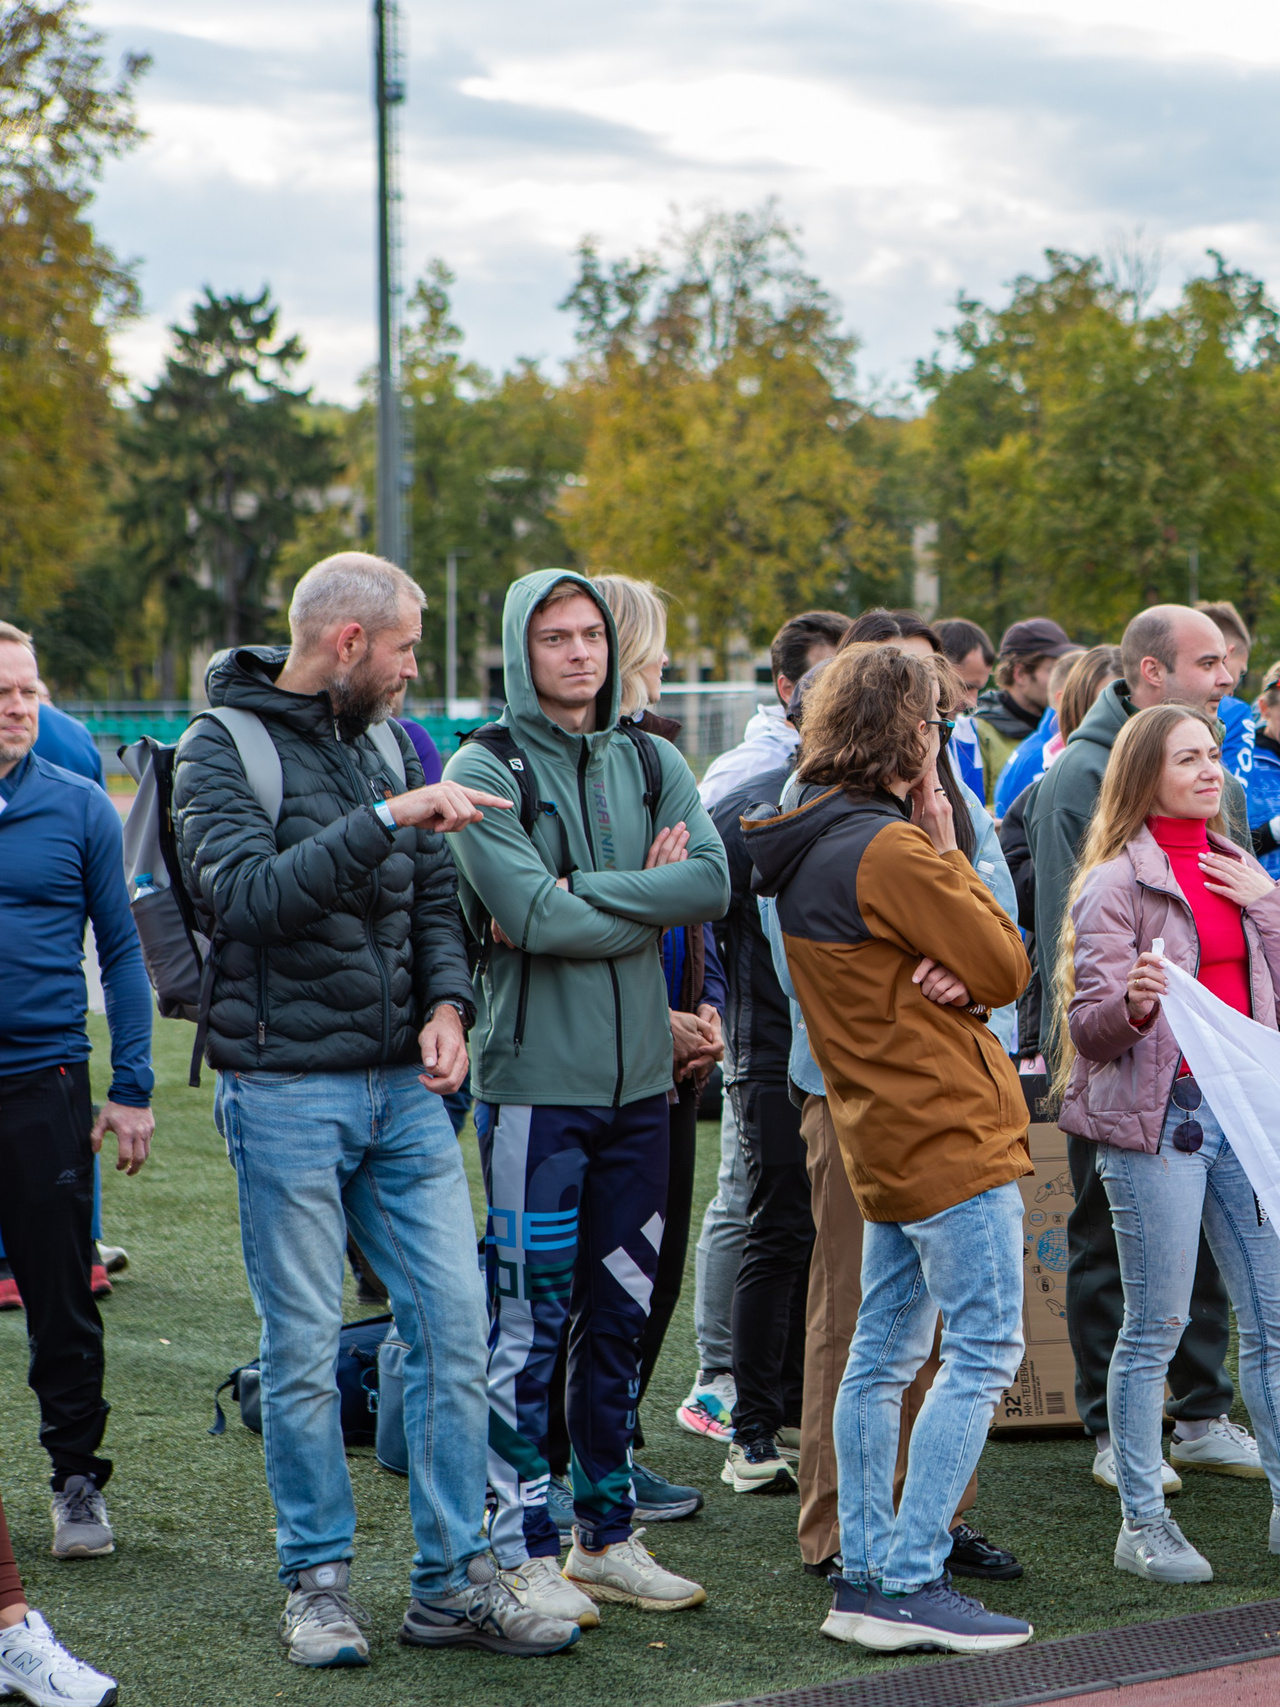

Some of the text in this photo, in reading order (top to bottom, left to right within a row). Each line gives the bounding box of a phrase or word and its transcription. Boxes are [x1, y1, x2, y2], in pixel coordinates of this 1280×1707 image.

[593, 780, 617, 870] TRAININ
[1003, 1389, 1022, 1418] 32"
[1019, 1350, 1033, 1417] ЖК-ТЕЛЕВИЗ
[11, 1651, 43, 1675] N
